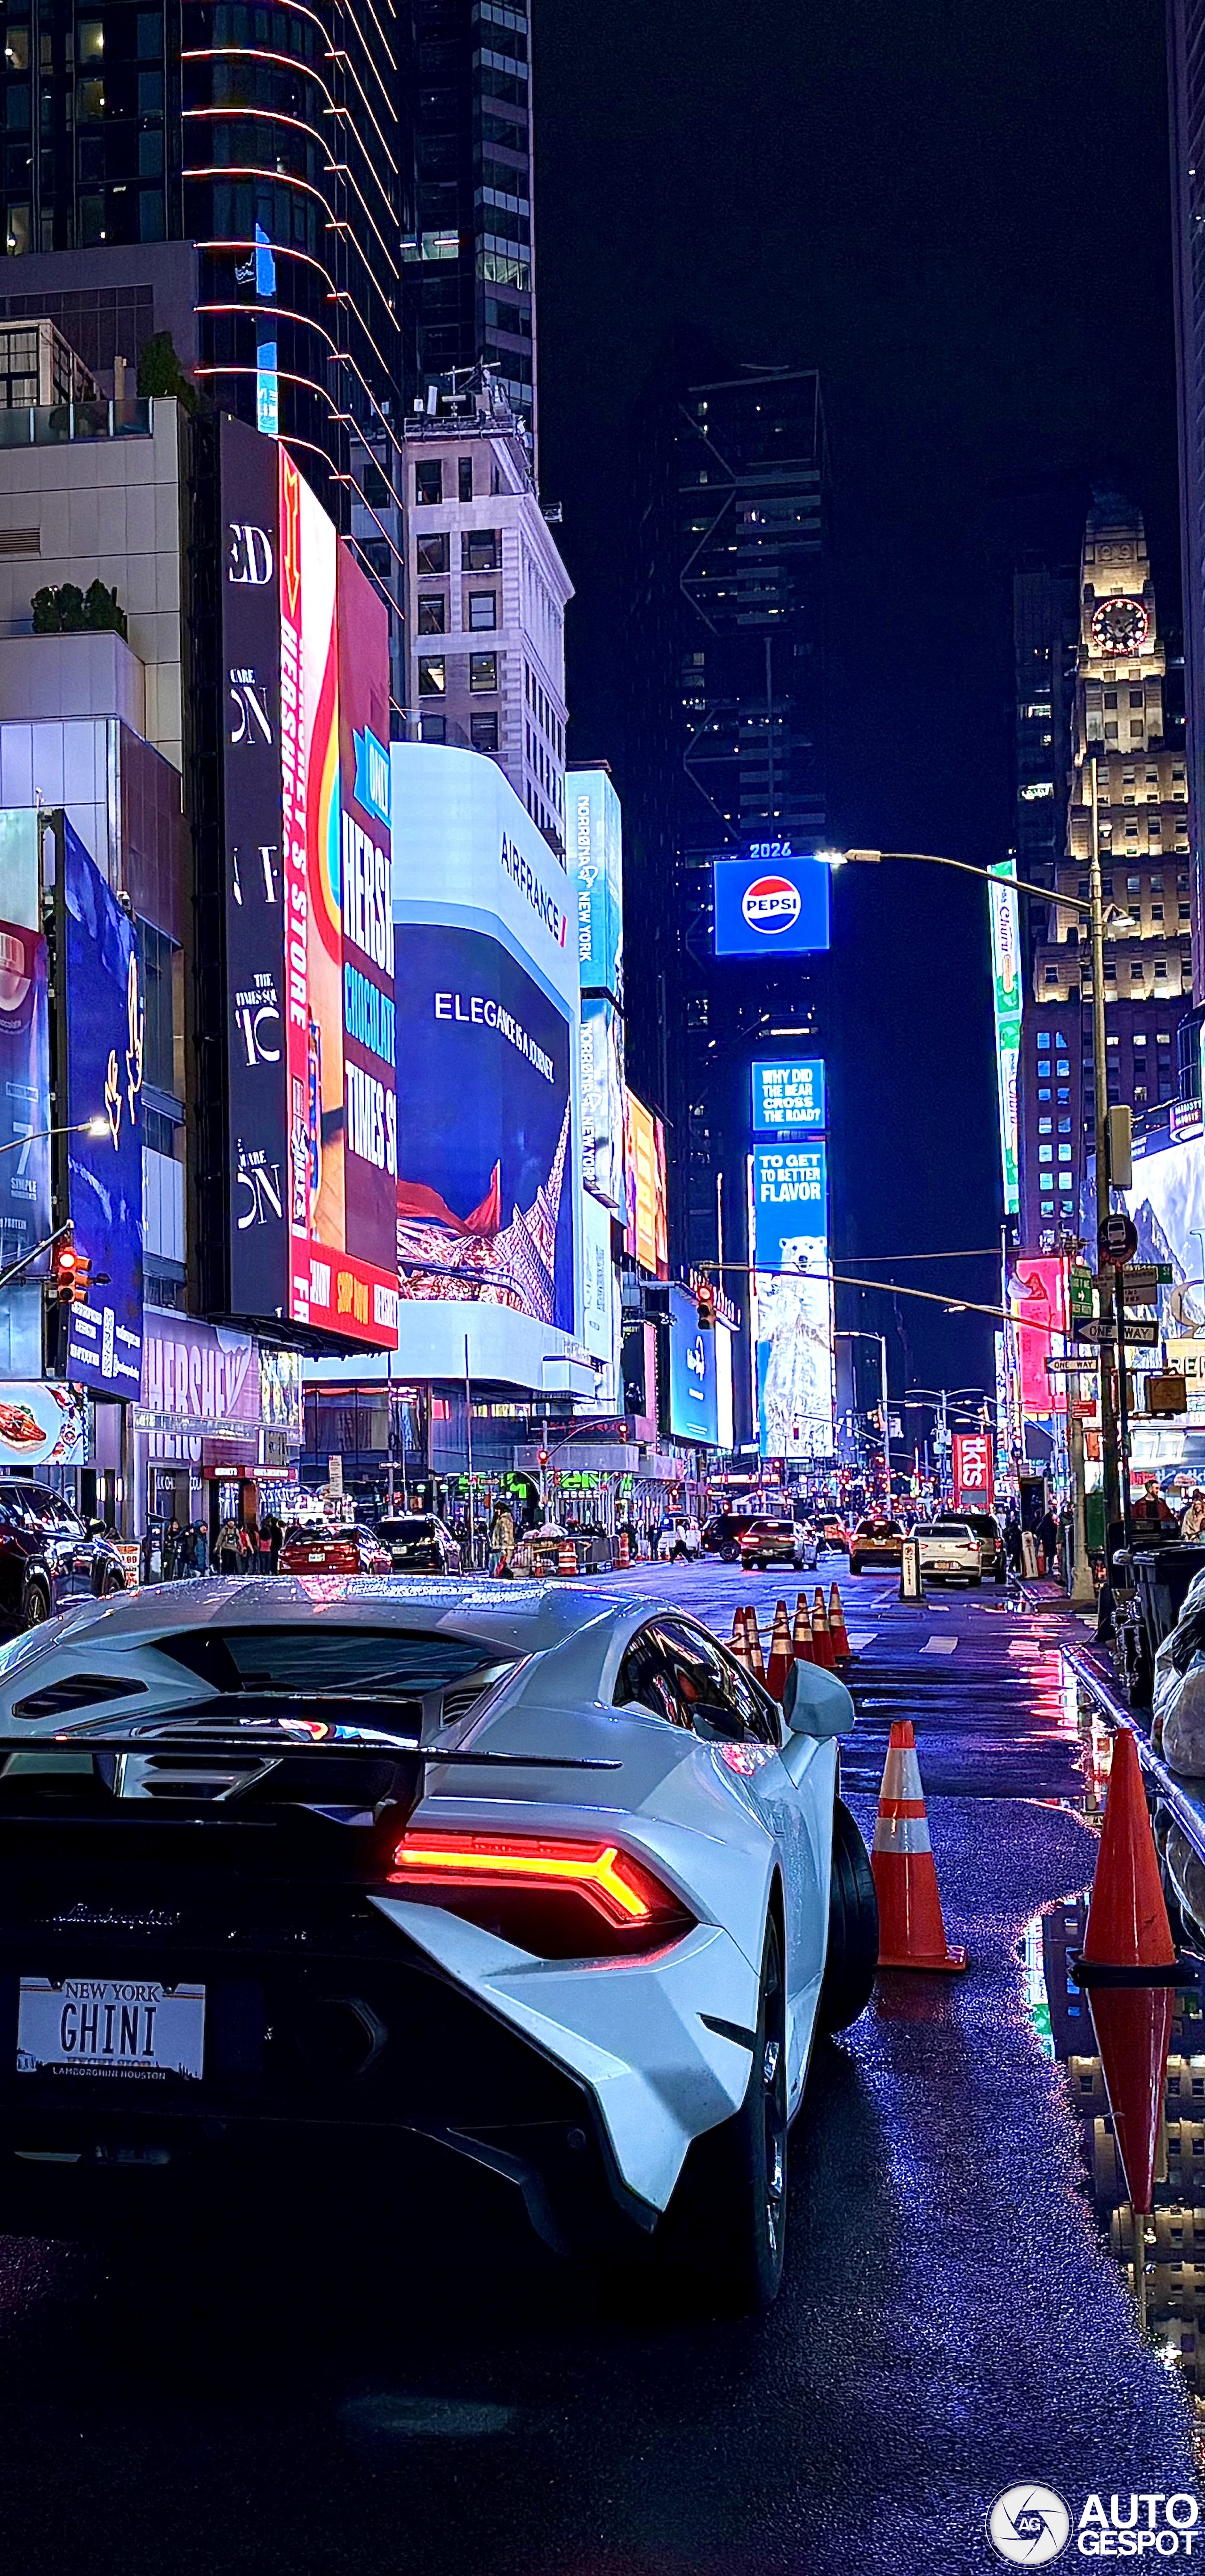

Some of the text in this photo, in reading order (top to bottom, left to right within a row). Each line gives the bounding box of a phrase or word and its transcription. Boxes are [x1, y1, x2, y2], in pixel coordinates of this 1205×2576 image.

[750, 843, 792, 858] 2026
[578, 891, 591, 923] NEW
[747, 899, 796, 911] PEPSI
[578, 924, 592, 962] YORK
[290, 883, 307, 1031] STORE
[435, 993, 515, 1044] ELEGANCE
[523, 1032, 528, 1058] A
[762, 1068, 813, 1084] WHY DID
[762, 1083, 812, 1098] THE BEAR
[763, 1096, 814, 1110] CROSS
[345, 1059, 385, 1170] TIMES
[763, 1108, 821, 1123] THE ROAD?
[759, 1154, 821, 1168] TO GET
[760, 1167, 821, 1182] TO BETTER
[760, 1181, 821, 1203] FLAVOR
[1089, 1325, 1149, 1339] ONE WAY
[1076, 1361, 1093, 1369] WAY
[962, 1436, 988, 1487] tkts
[65, 1982, 161, 2002] NEW YORK
[60, 2003, 157, 2056] GHINI
[53, 2067, 166, 2080] LAMBORGHINI HOUSTON
